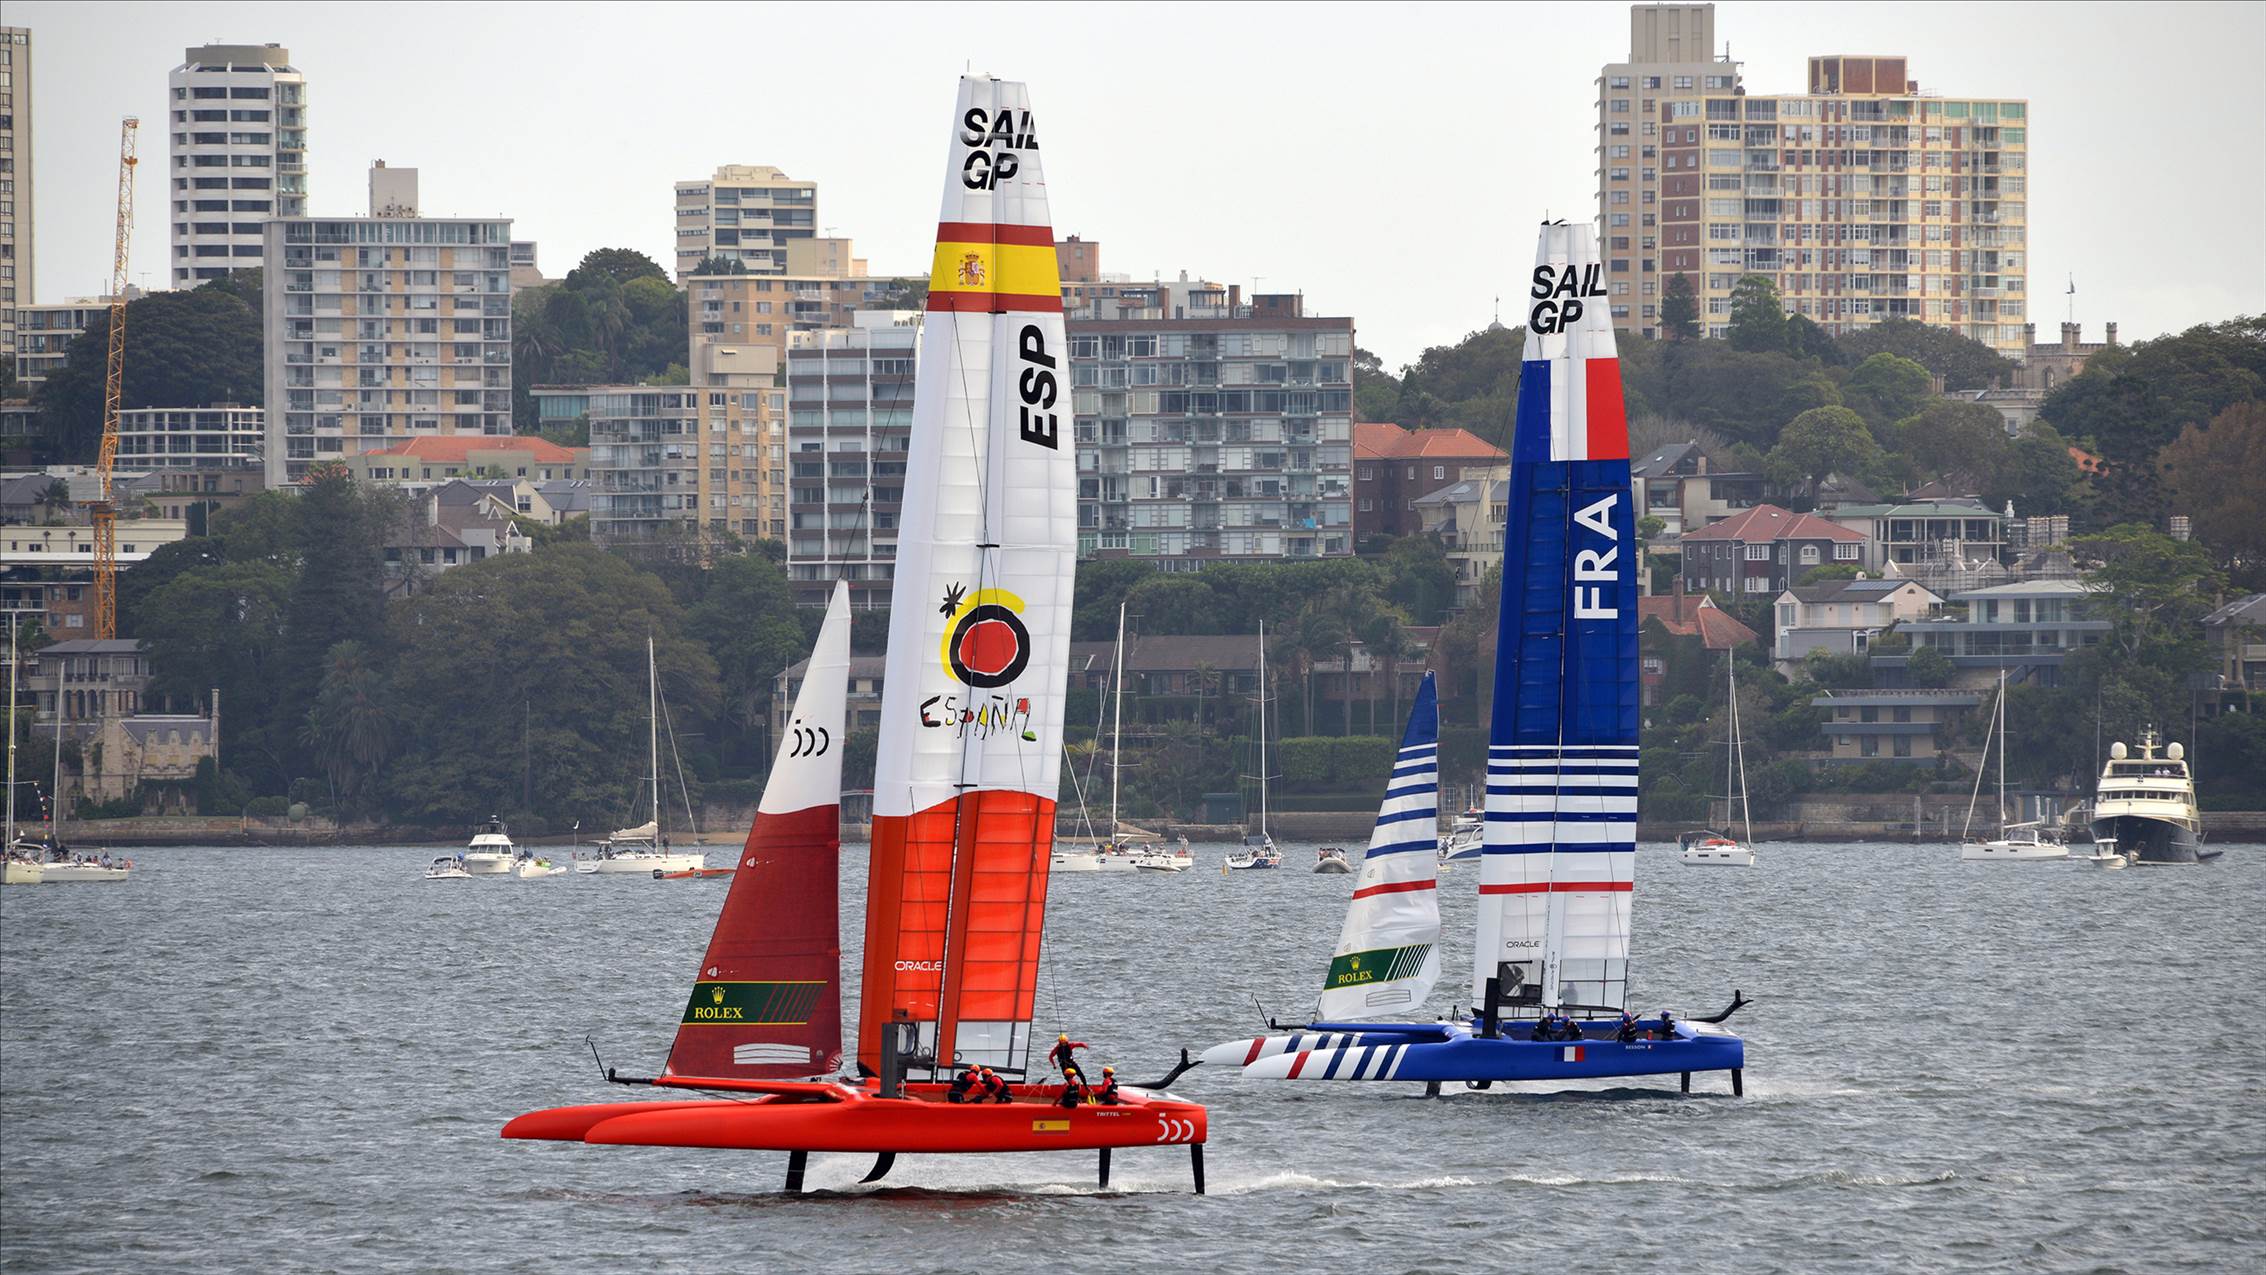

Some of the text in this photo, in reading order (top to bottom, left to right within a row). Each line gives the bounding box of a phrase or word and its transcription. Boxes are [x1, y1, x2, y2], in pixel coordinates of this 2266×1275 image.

[960, 107, 1039, 150] SAIL
[961, 150, 1019, 191] GP
[1531, 263, 1607, 300] SAIL
[1529, 300, 1583, 335] GP
[1019, 324, 1058, 450] ESP
[1574, 493, 1618, 619] FRA
[1506, 940, 1541, 948] ORACLE
[894, 961, 943, 971] ORACLE
[1338, 970, 1373, 984] ROLEX
[694, 1007, 743, 1019] ROLEX
